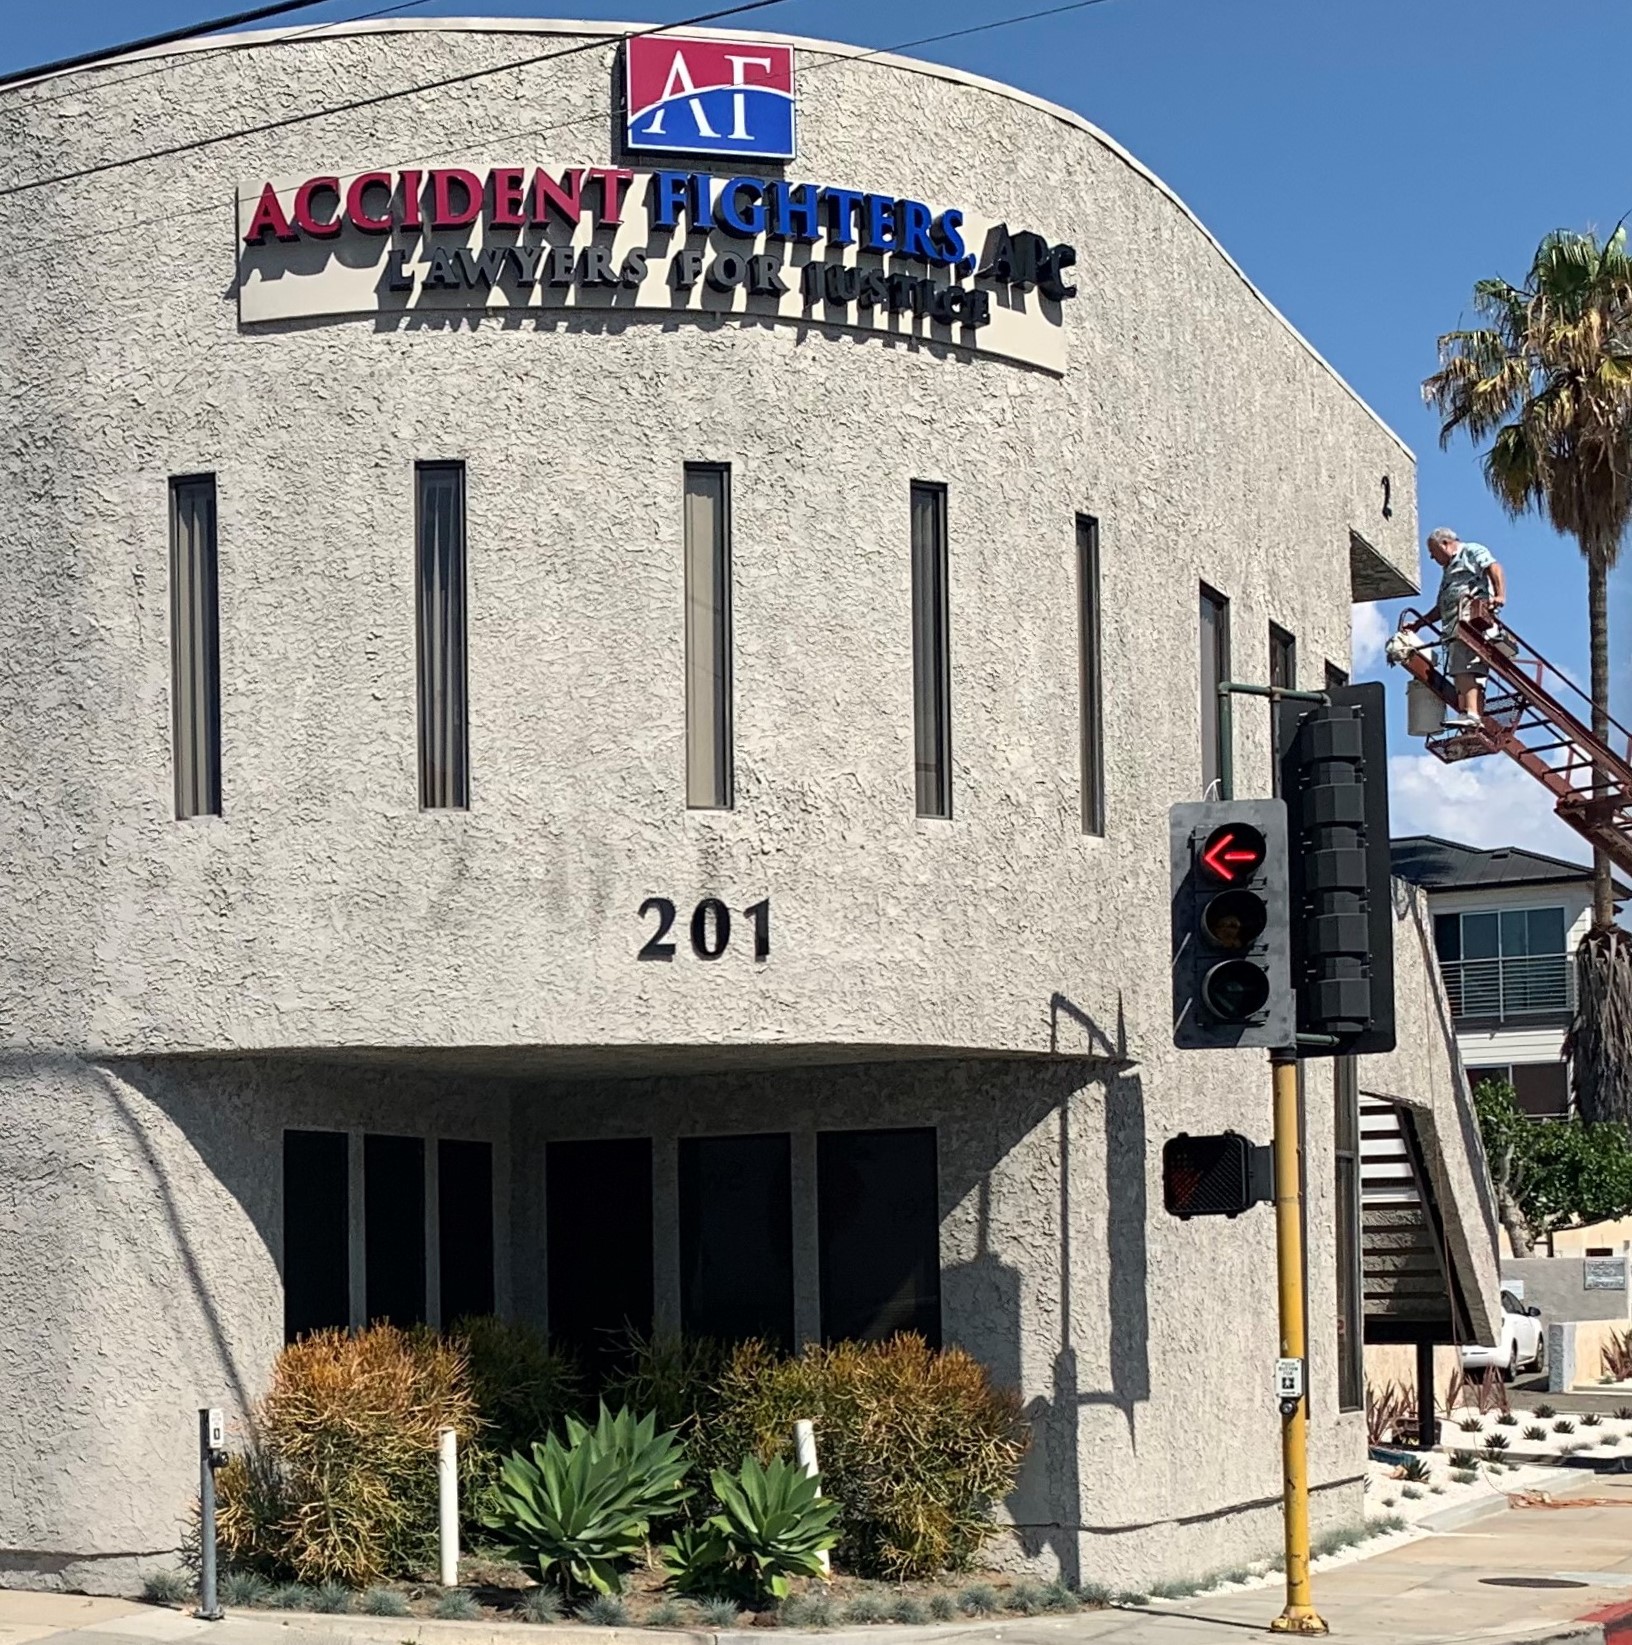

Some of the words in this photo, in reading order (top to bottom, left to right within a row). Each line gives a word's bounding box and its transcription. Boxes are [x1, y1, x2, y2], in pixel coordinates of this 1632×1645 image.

[641, 49, 772, 141] AF
[242, 167, 634, 246] ACCIDENT
[652, 168, 977, 277] FIGHTERS,
[387, 245, 649, 292] LAWYERS
[673, 249, 790, 298] FOR
[801, 260, 991, 329] JUSTICE
[637, 897, 770, 959] 201
